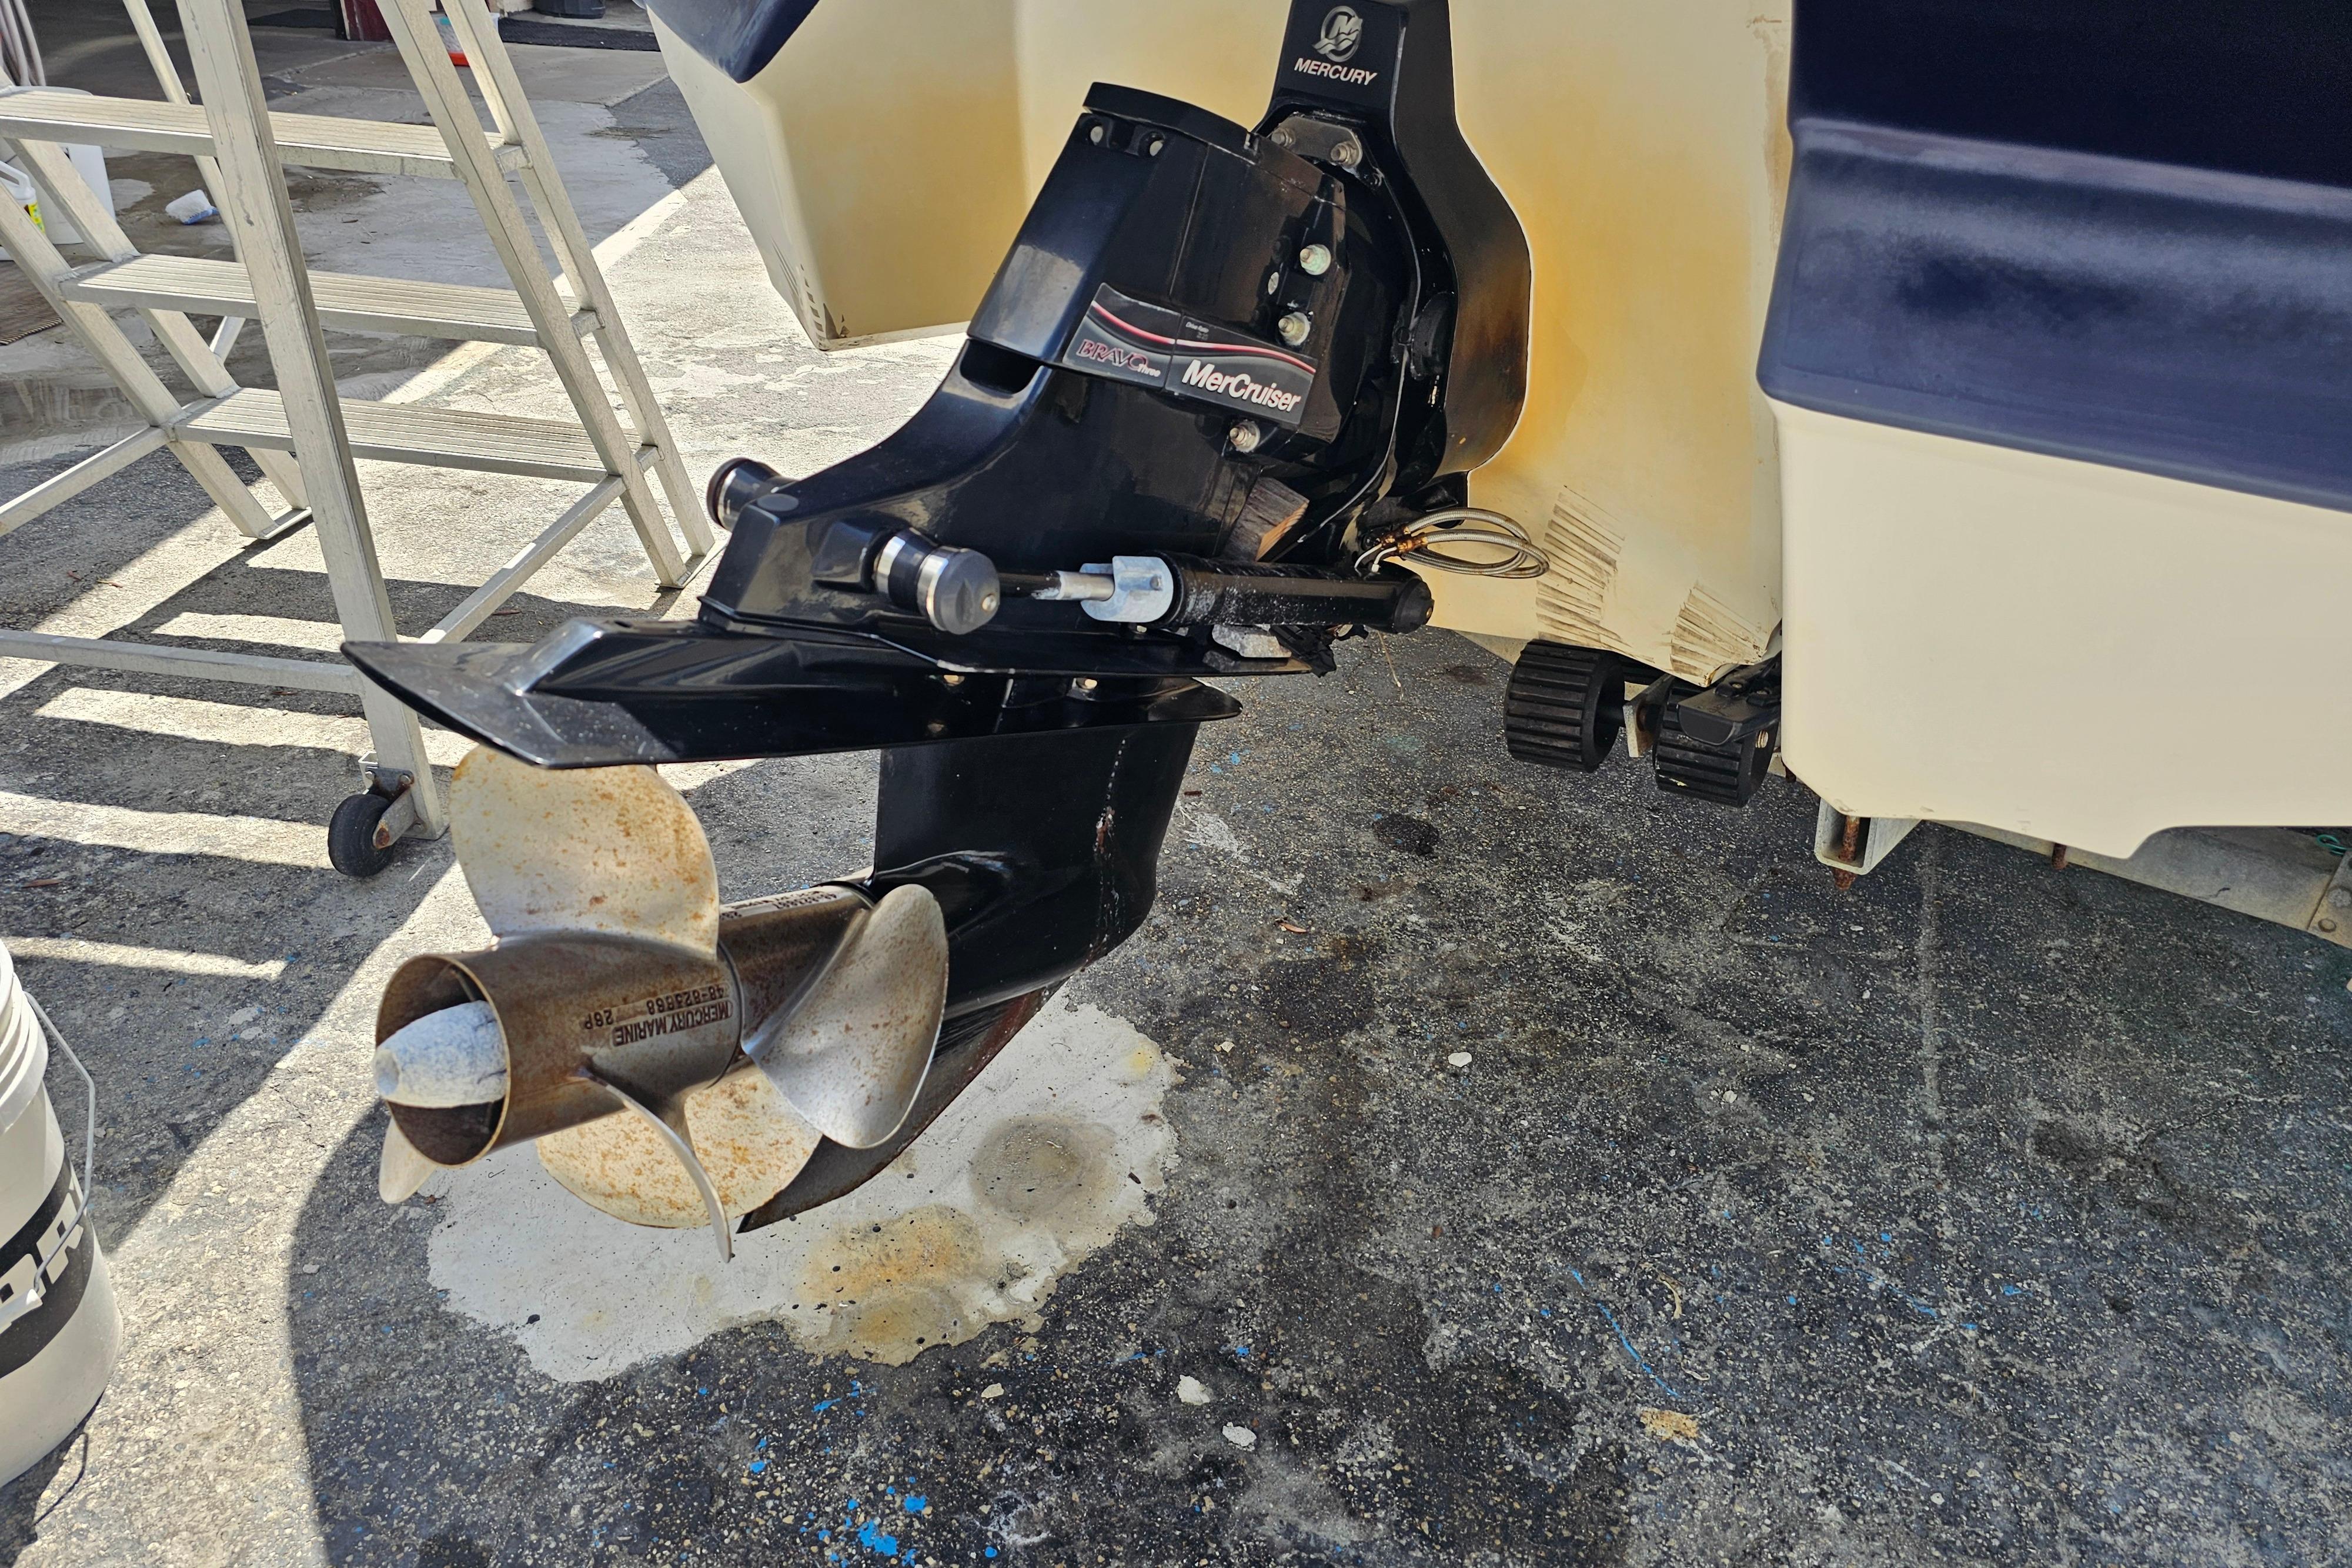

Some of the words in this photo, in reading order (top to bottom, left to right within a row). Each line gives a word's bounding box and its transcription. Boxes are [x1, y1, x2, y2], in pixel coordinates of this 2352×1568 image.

[1294, 58, 1378, 86] MERCURY
[1075, 339, 1149, 372] BRAVO
[1137, 363, 1161, 377] Three
[1181, 359, 1302, 413] MerCruiser
[613, 1015, 667, 1047] MARINE
[670, 1001, 730, 1034] MERCURY
